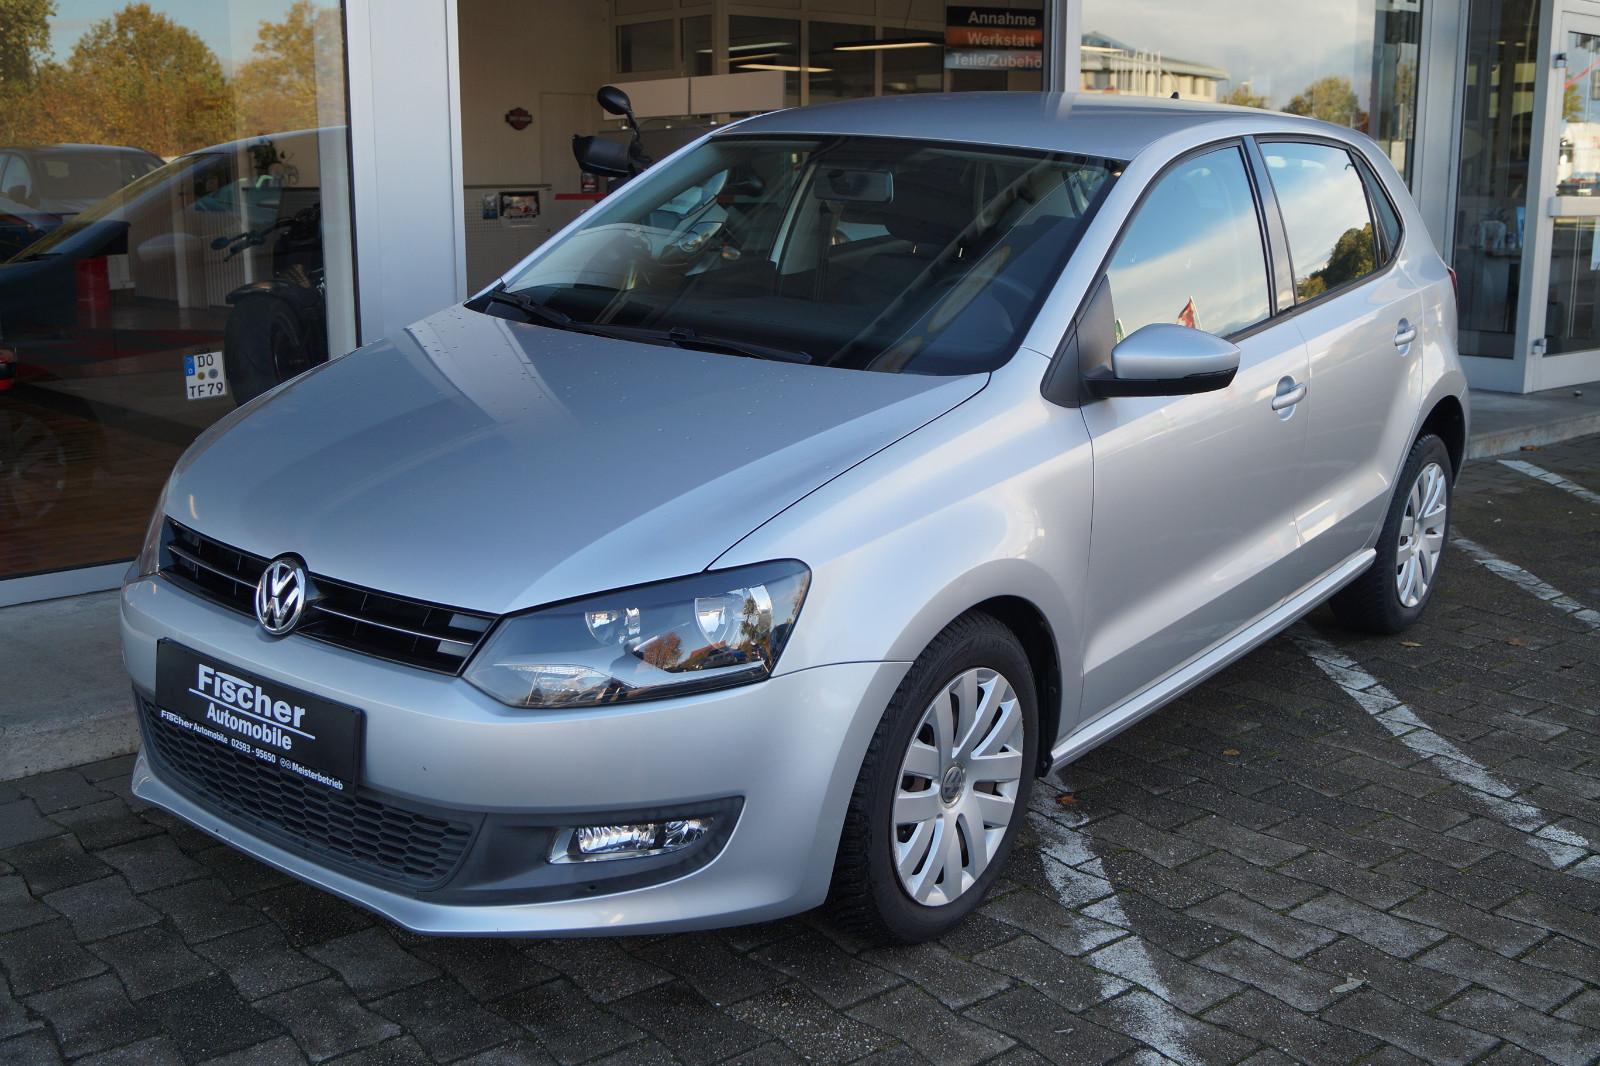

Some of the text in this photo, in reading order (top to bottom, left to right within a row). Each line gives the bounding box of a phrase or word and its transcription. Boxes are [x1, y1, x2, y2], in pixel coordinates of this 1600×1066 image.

[968, 10, 1036, 26] Annahme
[968, 31, 1035, 47] Werkstatt
[197, 354, 214, 368] DO
[189, 382, 223, 398] TF 79
[198, 664, 306, 728] Fischer
[206, 702, 292, 750] Automobile
[160, 709, 193, 729] Fischer
[193, 722, 228, 744] Automobile
[231, 738, 251, 754] 02593
[255, 748, 276, 764] 95650
[292, 762, 344, 791] Meisterbetrieb
